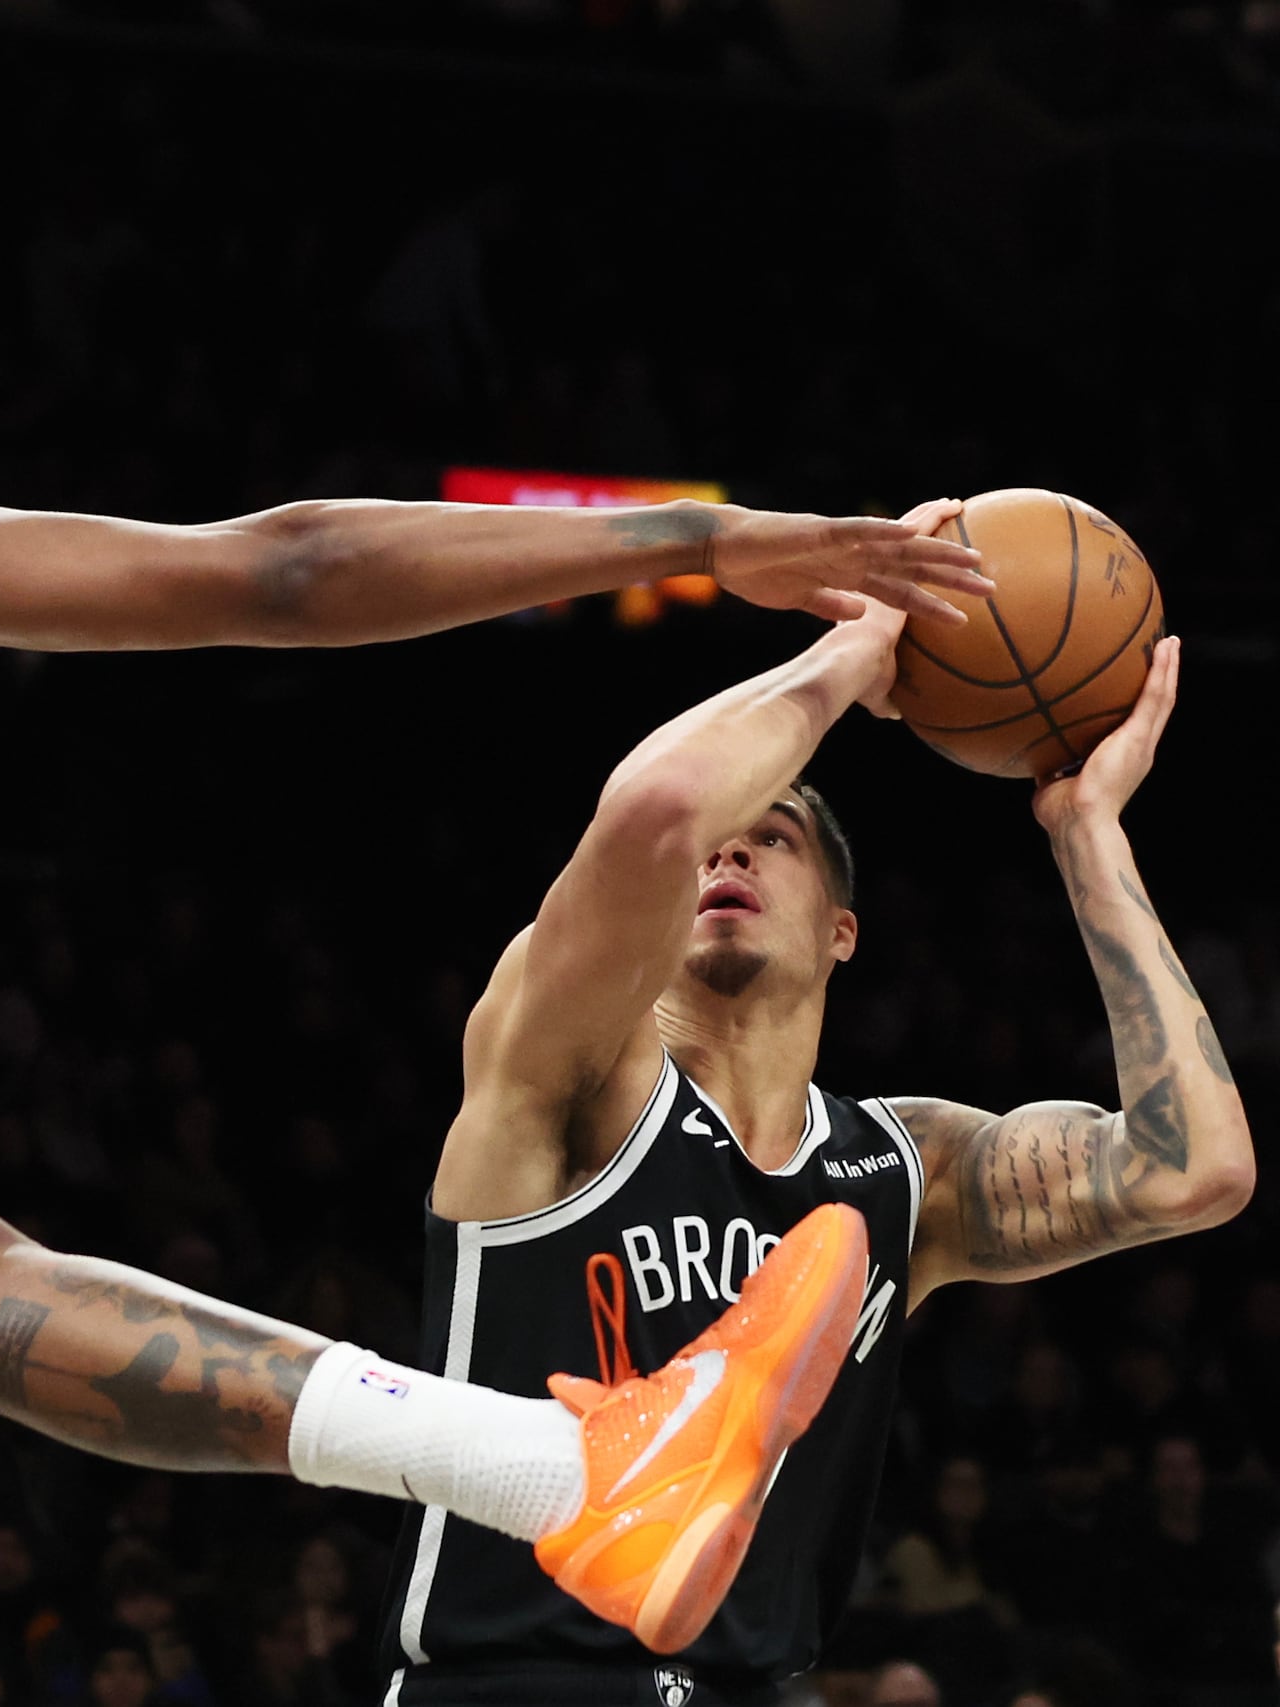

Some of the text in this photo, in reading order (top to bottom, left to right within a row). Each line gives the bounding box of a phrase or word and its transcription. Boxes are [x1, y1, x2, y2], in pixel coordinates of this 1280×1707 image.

[823, 1151, 900, 1178] All In Won
[621, 1214, 896, 1363] BRON
